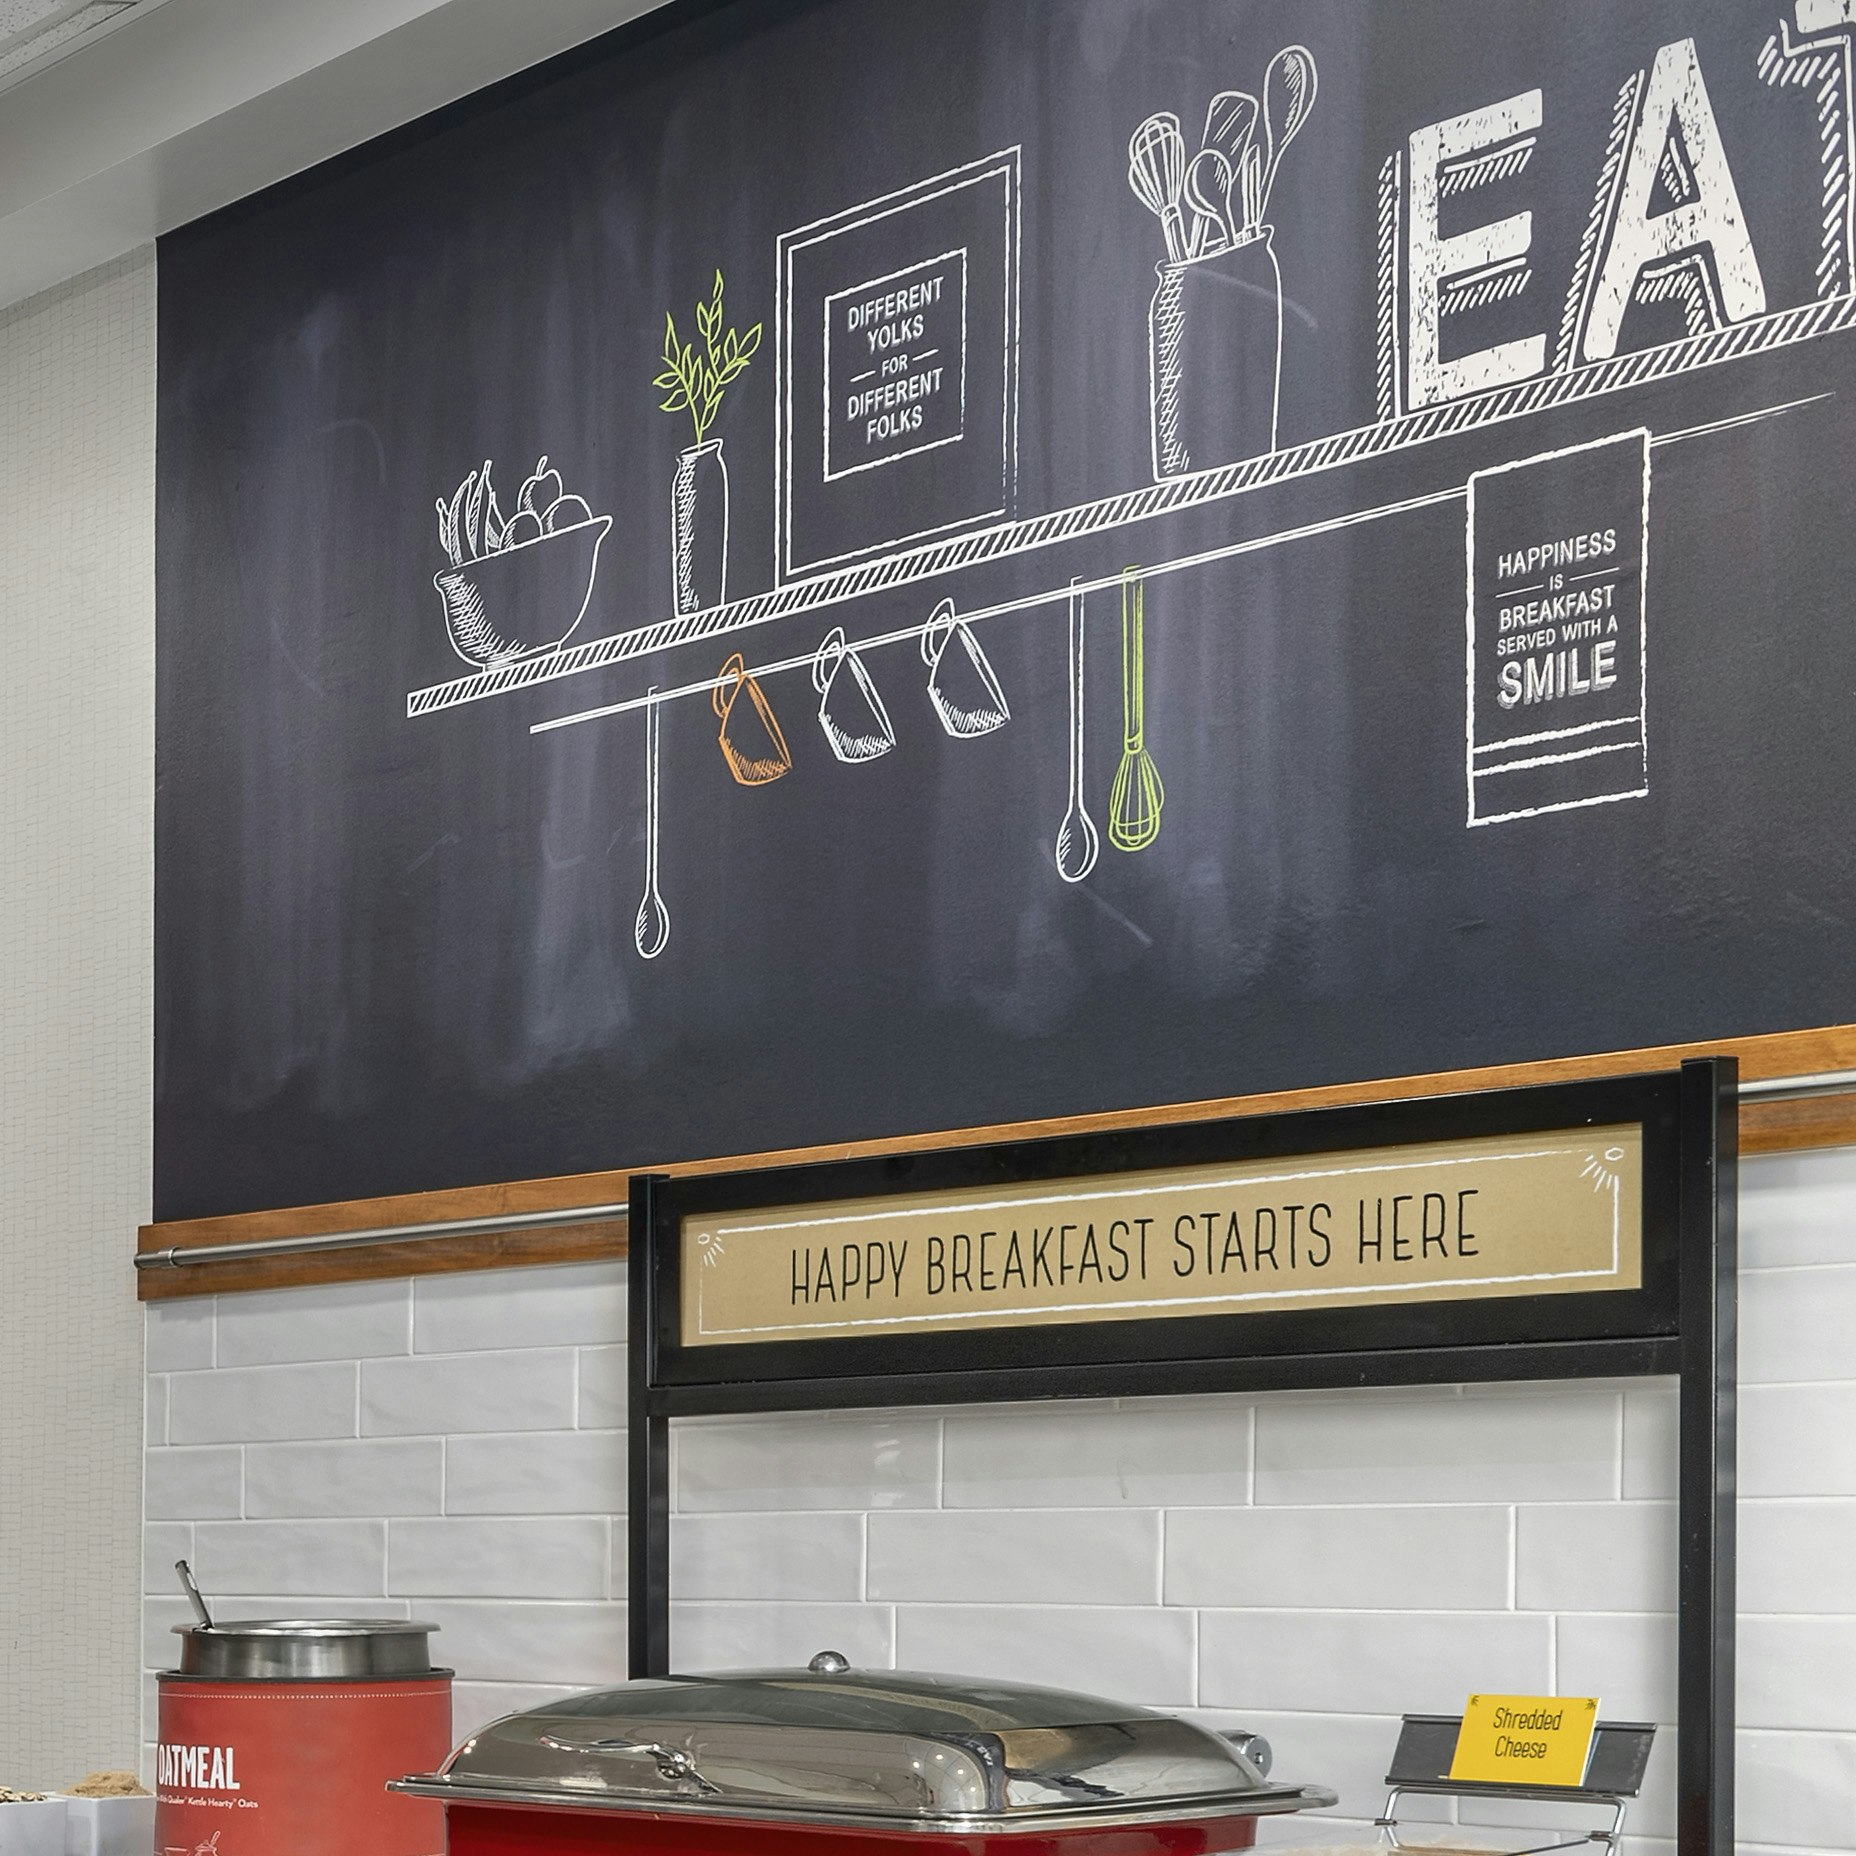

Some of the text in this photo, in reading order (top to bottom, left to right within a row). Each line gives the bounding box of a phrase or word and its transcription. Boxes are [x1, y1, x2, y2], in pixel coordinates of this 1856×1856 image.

[847, 276, 944, 332] DIFFERENT
[867, 315, 925, 355] YOLKS
[881, 353, 908, 378] FOR
[847, 367, 943, 421] DIFFERENT
[866, 404, 923, 445] FOLKS
[1497, 528, 1617, 579] HAPPINESS
[1549, 573, 1564, 591] IS
[1499, 584, 1616, 633] BREAKFAST
[1496, 614, 1618, 656] SERVED WITH A
[1497, 640, 1617, 709] SMILE
[792, 1190, 1479, 1306] HAPPY BREAKFAST STARTS HERE
[1493, 1706, 1564, 1731] Shredded
[158, 1744, 240, 1790] OATMEAL
[1494, 1735, 1548, 1759] Cheese
[238, 1798, 259, 1809] Oats
